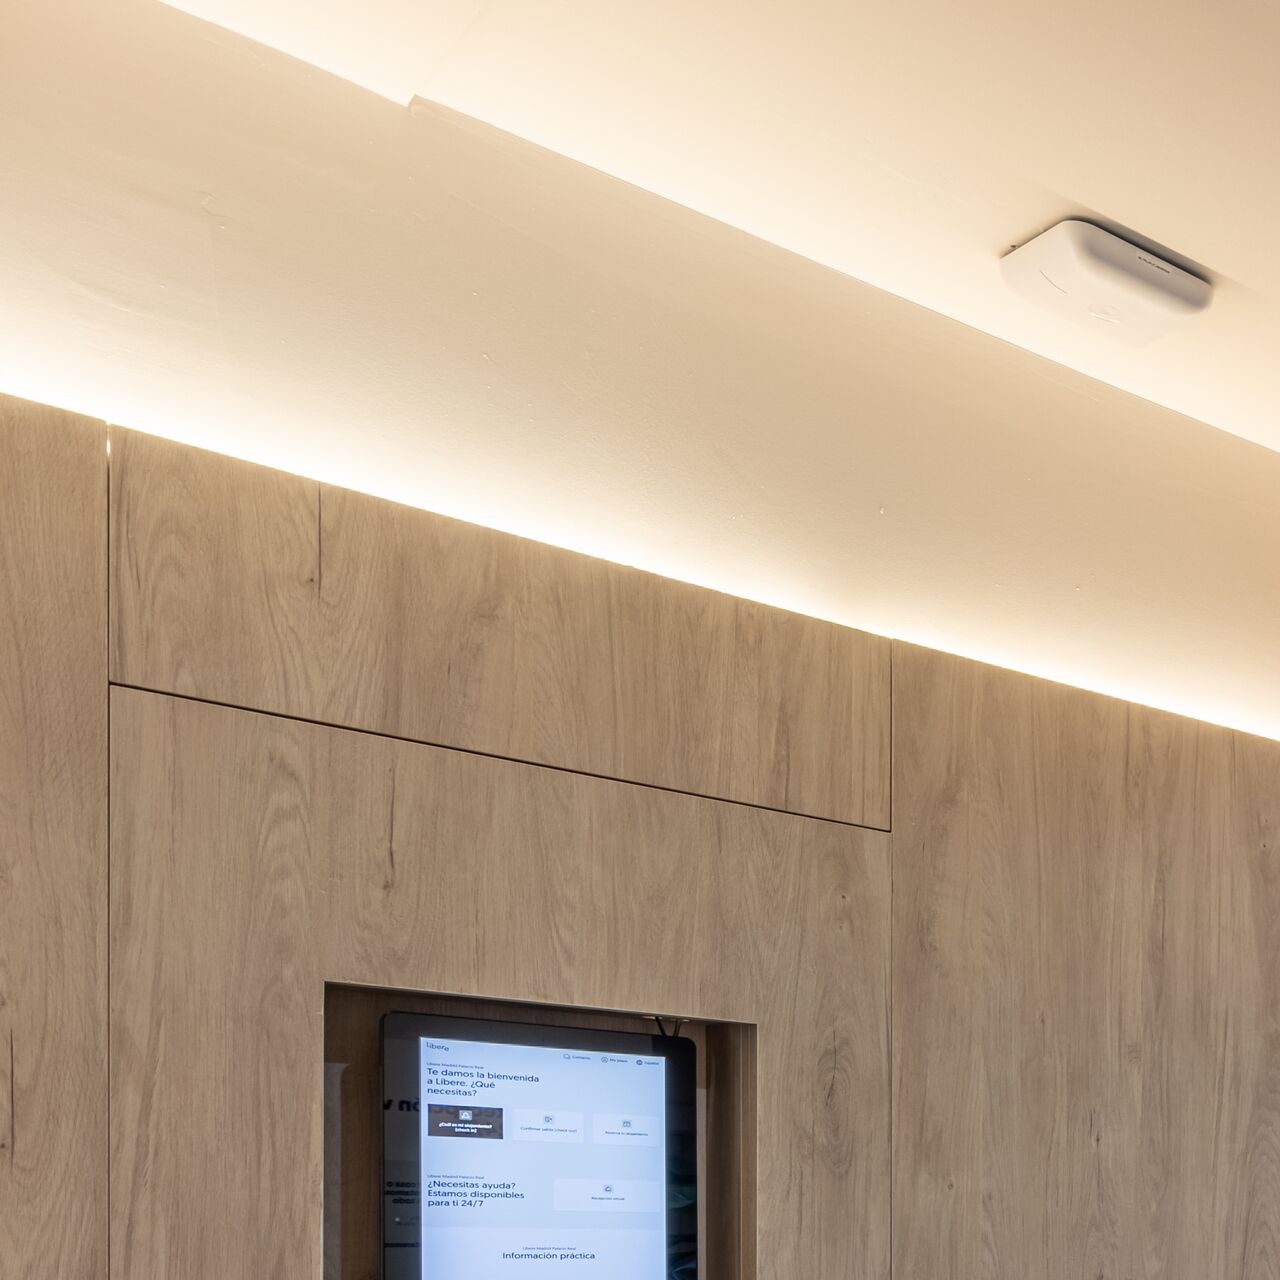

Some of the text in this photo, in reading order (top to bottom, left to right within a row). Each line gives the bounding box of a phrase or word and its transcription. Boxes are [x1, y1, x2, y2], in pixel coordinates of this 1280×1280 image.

[427, 1067, 540, 1082] Te damos la bienvenida
[470, 1080, 496, 1089] ¿Qué
[427, 1087, 477, 1097] necesitas?
[427, 1180, 516, 1190] ¿Necesitas ayuda?
[427, 1190, 525, 1200] Estamos disponibles
[428, 1200, 450, 1208] para
[461, 1200, 484, 1208] 24/7
[502, 1252, 596, 1262] Información práctica
